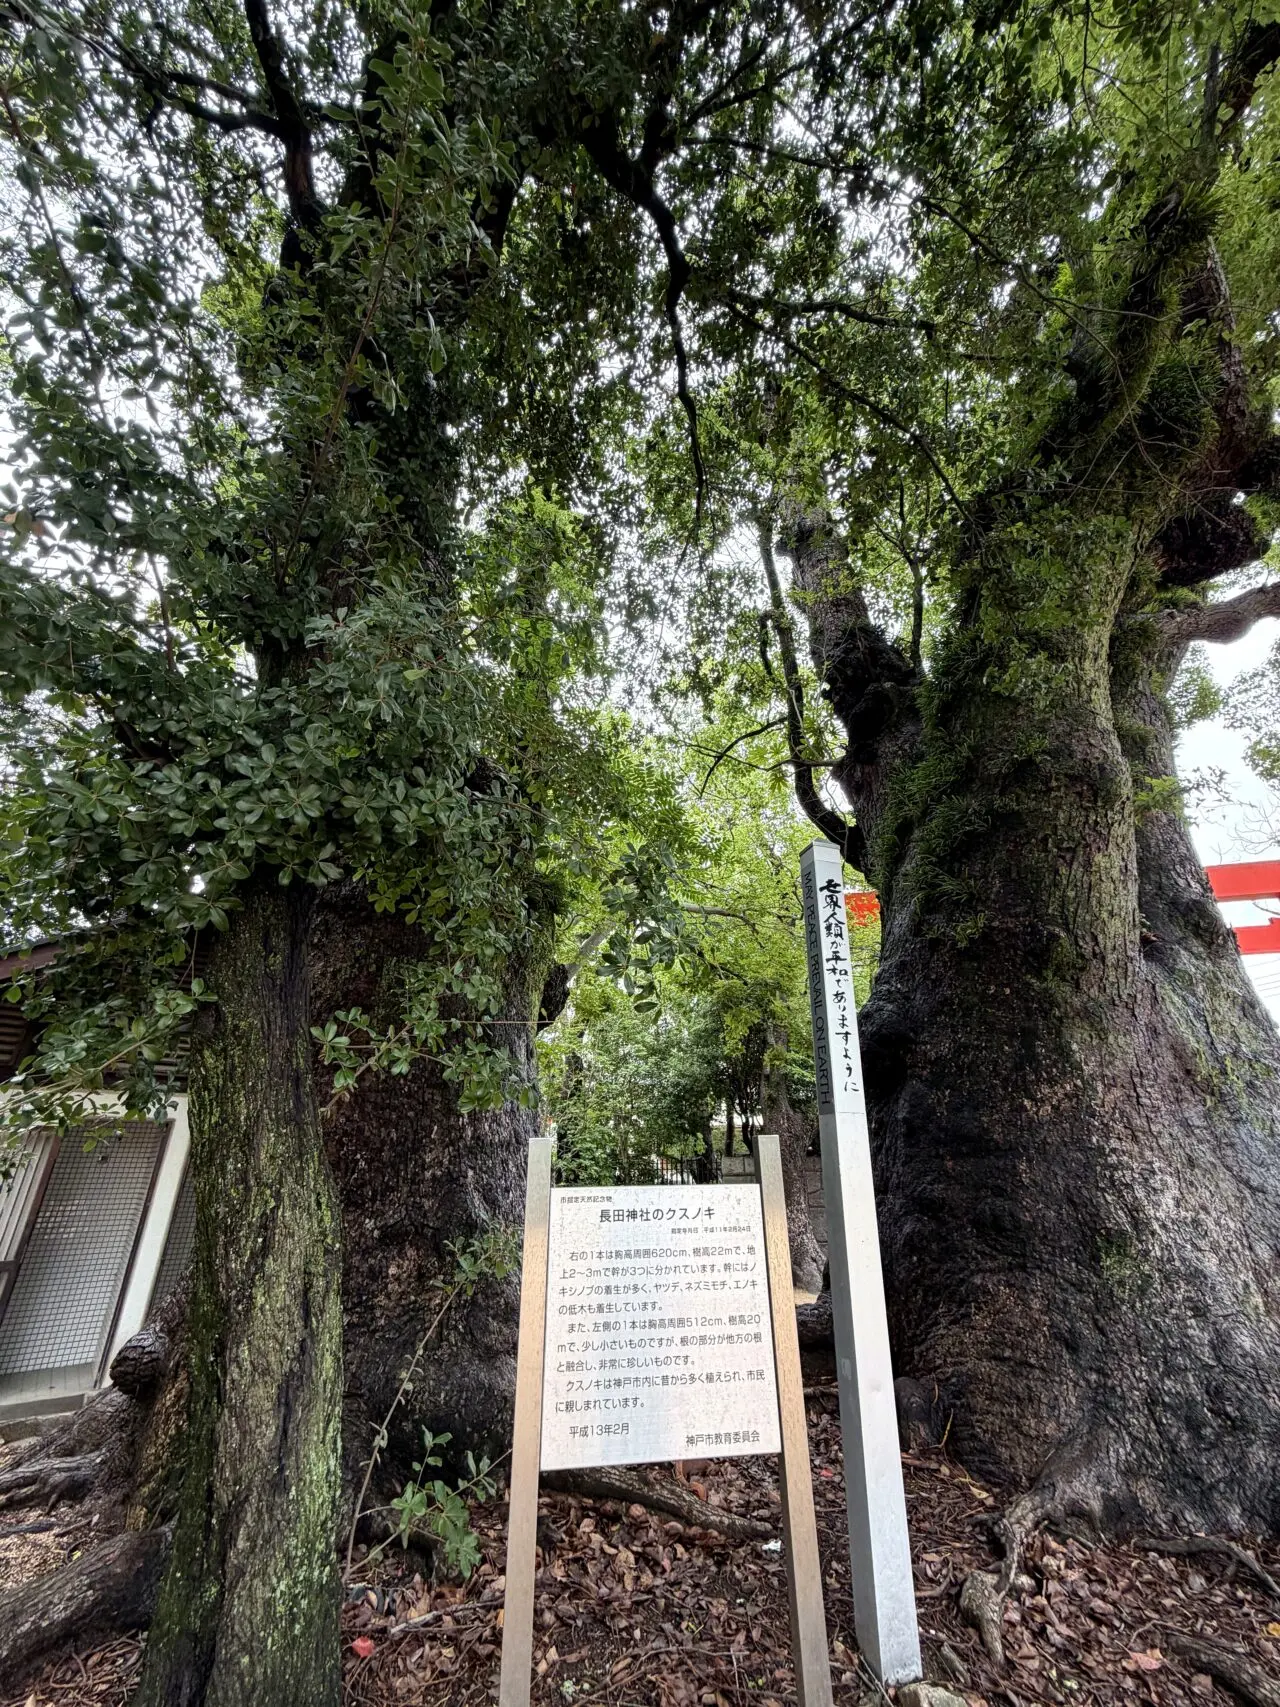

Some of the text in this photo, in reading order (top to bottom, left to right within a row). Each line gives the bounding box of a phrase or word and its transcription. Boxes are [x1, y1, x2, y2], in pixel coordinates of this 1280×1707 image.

[804, 871, 830, 1104] MAY PEACE PREVAIL ON EARTH
[819, 879, 859, 1092] 世界人類が平和でありますように
[561, 1196, 612, 1204] 市指定天然記念物
[600, 1207, 715, 1223] 長田神社のクスノキ
[569, 1247, 756, 1261] 右の1本は胸高周囲620cm、樹高22mで、地
[559, 1301, 663, 1315] の低木も着生しています。
[568, 1315, 760, 1333] また、左側の1本は胸高周囲512cm、樹高20
[558, 1332, 762, 1353] mで、少し小さいものですが、根の部分が他方の根
[557, 1355, 695, 1373] と融合し、非常に珍しいものです。
[566, 1369, 765, 1392] クスノキは神戸市内に昔から多く植えられ、市民
[556, 1397, 645, 1413] に親しまれています。
[569, 1423, 630, 1438] 平成13年2月
[686, 1430, 760, 1447] 神戸市教育委員会
